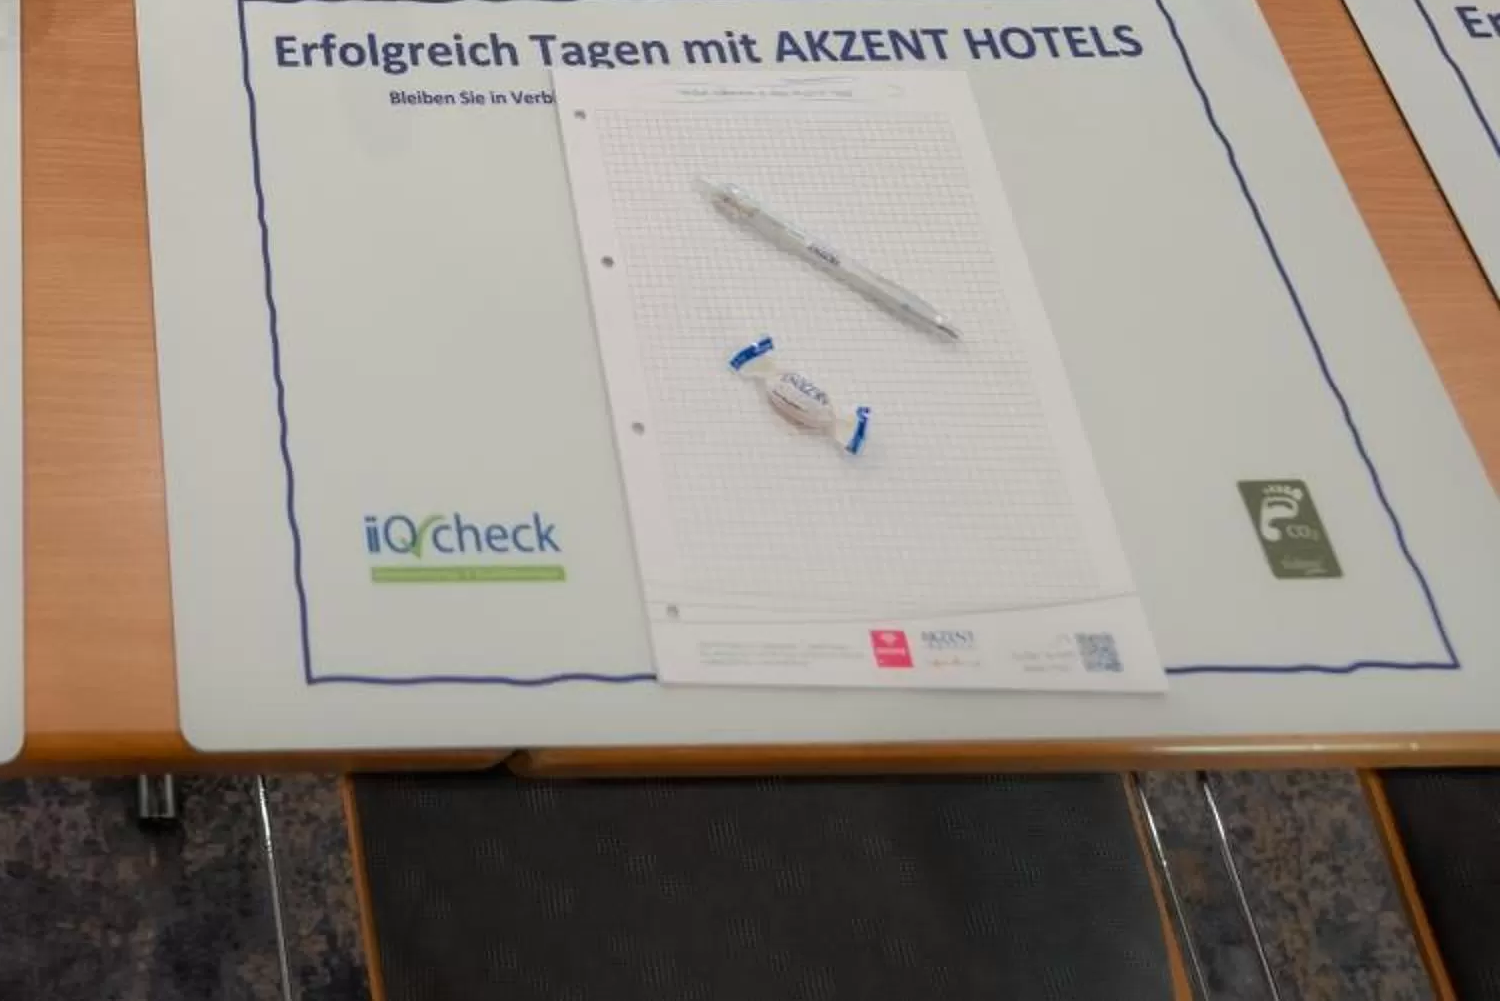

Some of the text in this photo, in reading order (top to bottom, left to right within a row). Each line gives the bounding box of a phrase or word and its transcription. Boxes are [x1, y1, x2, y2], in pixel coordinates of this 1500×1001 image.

[274, 24, 1143, 74] Erfolgreich Tagen mit AKZENT HOTELS
[389, 90, 456, 105] Bleiben
[459, 90, 485, 105] Sie
[490, 90, 507, 104] in
